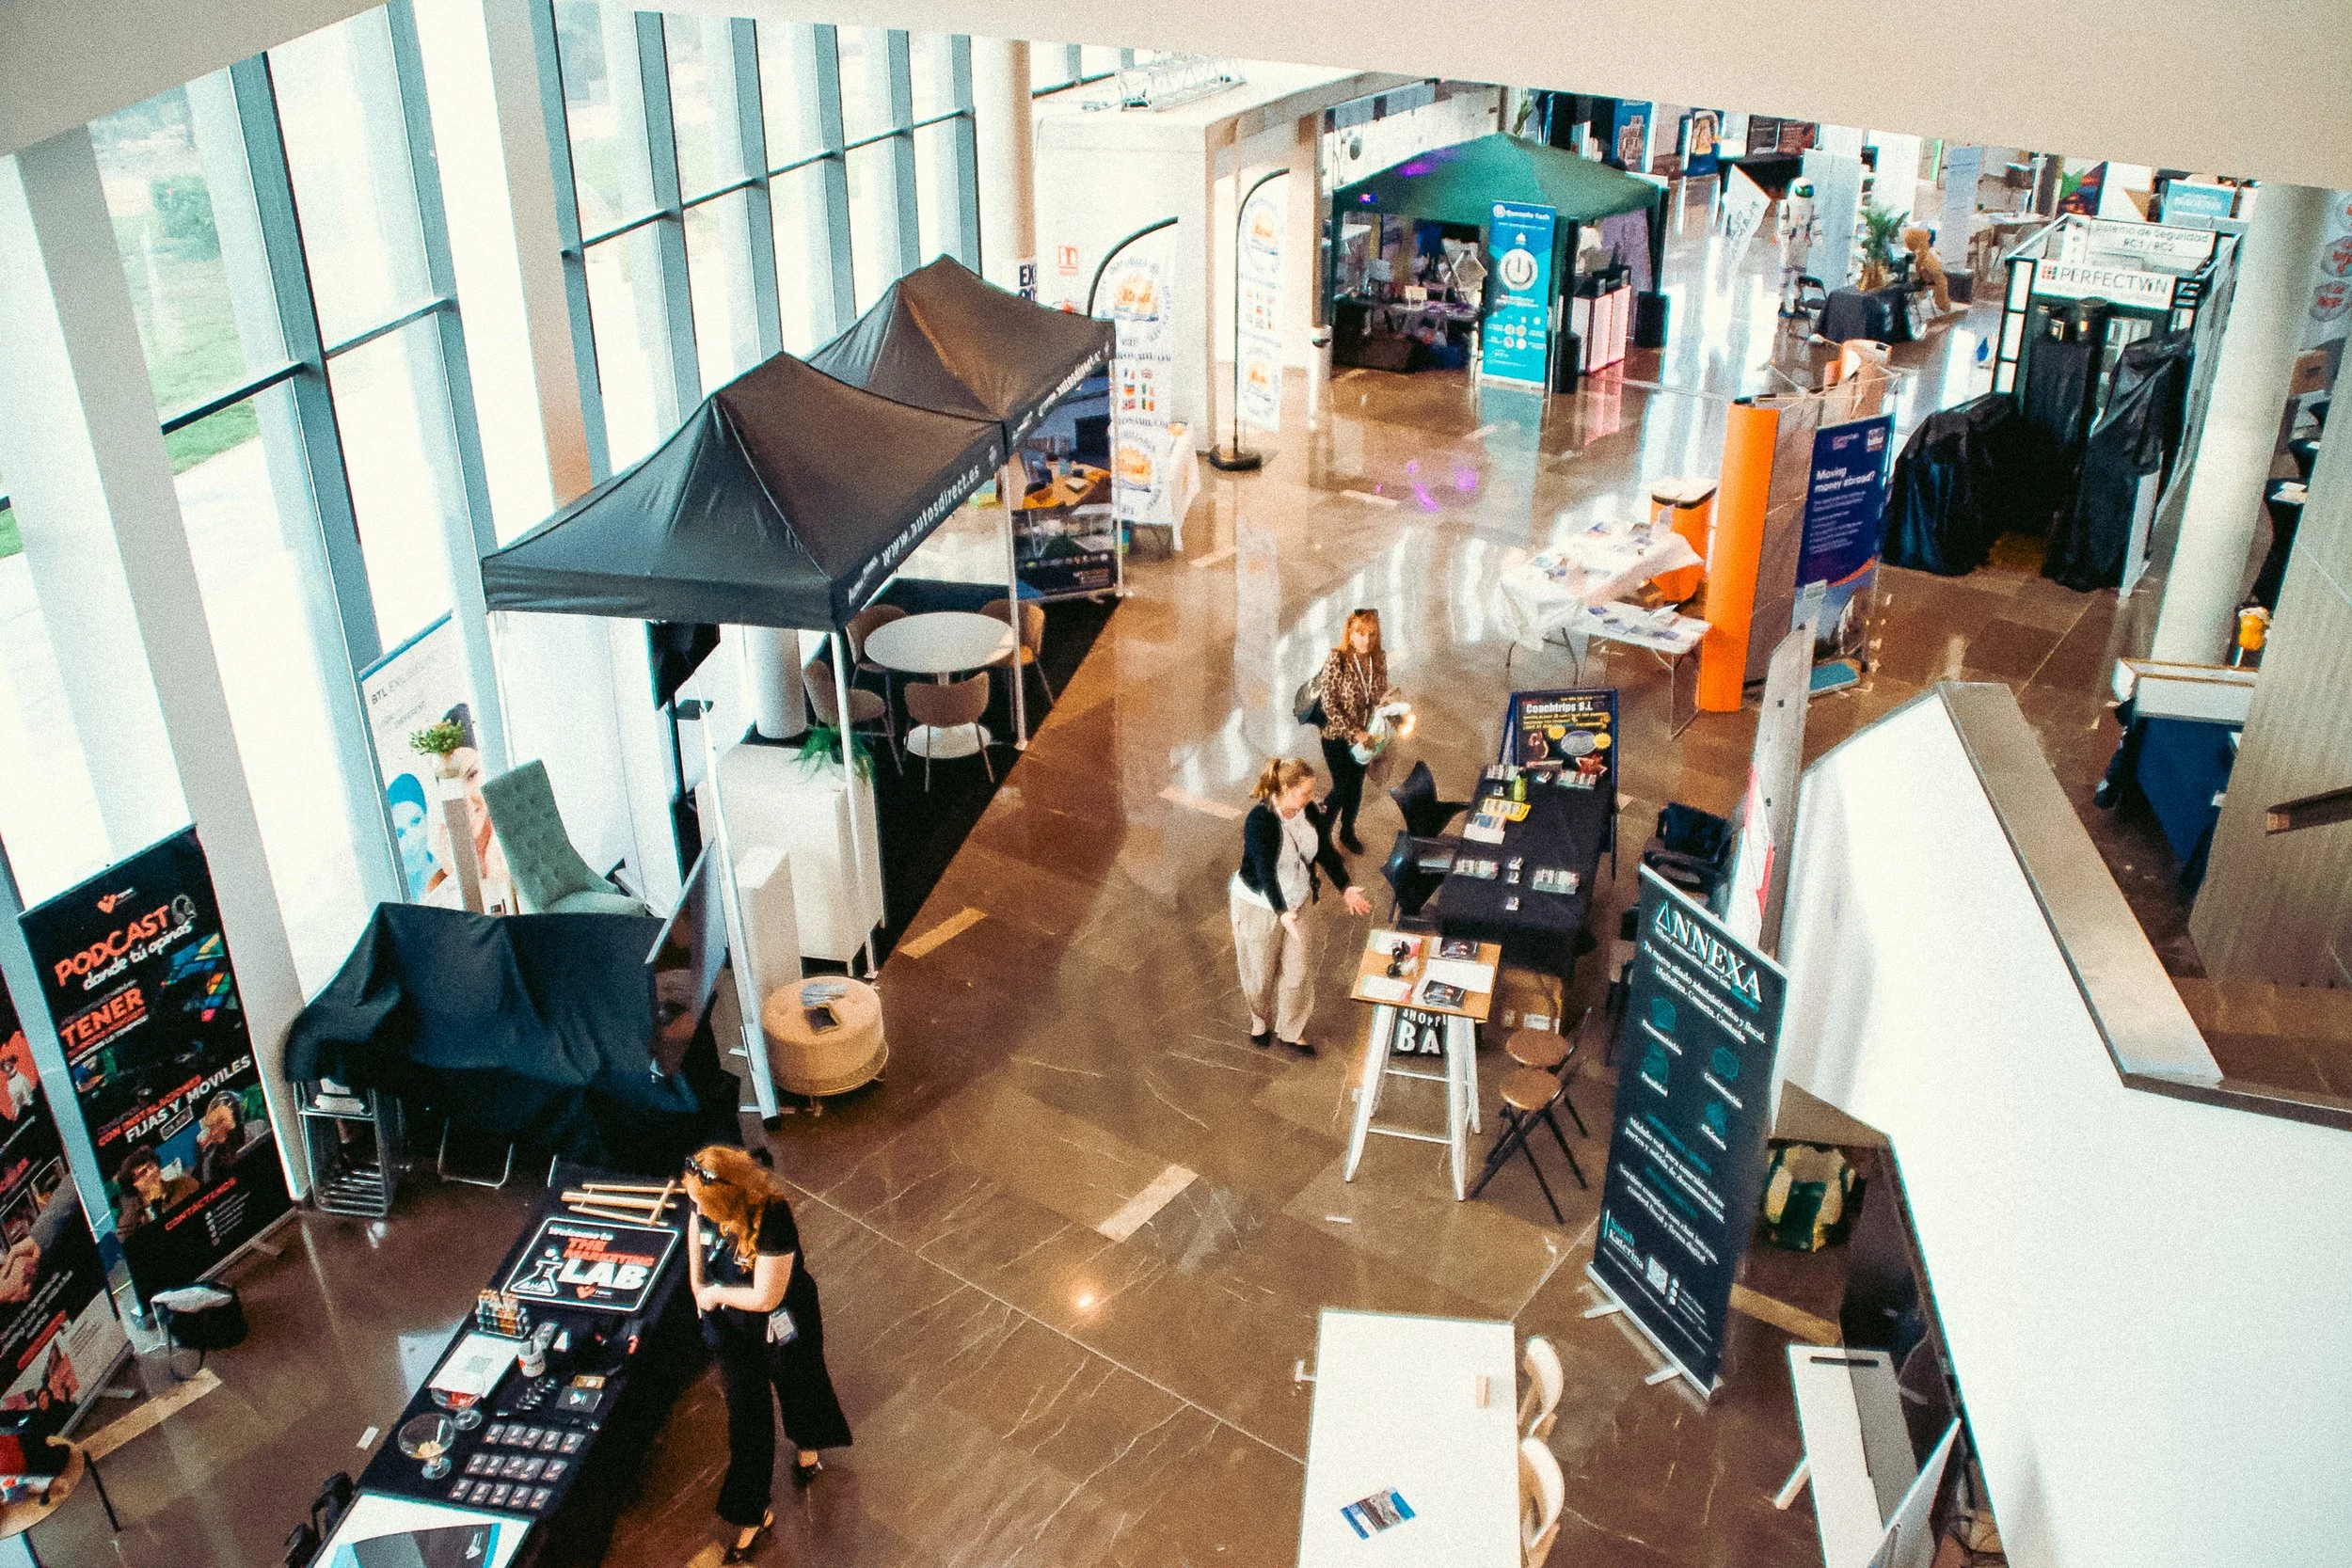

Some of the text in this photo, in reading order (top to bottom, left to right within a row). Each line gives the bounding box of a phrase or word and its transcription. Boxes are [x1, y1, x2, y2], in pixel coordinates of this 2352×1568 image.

[1814, 470, 1876, 494] money abroad?
[1816, 467, 1847, 482] Moving
[882, 465, 980, 566] www.autosdirect.es
[1526, 702, 1577, 714] Coachtrips
[54, 905, 170, 988] PODCAST
[83, 920, 194, 991] donde tú opinas
[1656, 900, 1763, 1003] ANNEXA
[59, 987, 145, 1048] TENER
[1403, 1008, 1447, 1027] SHOPPI
[1397, 1019, 1440, 1054] BA
[124, 1108, 169, 1144] FIJAS
[169, 1098, 182, 1114] Y
[186, 1054, 251, 1104] MOVILES
[548, 1227, 614, 1242] Welcome to
[567, 1237, 609, 1253] THE
[557, 1257, 649, 1291] LAB
[563, 1248, 656, 1267] MARKETING
